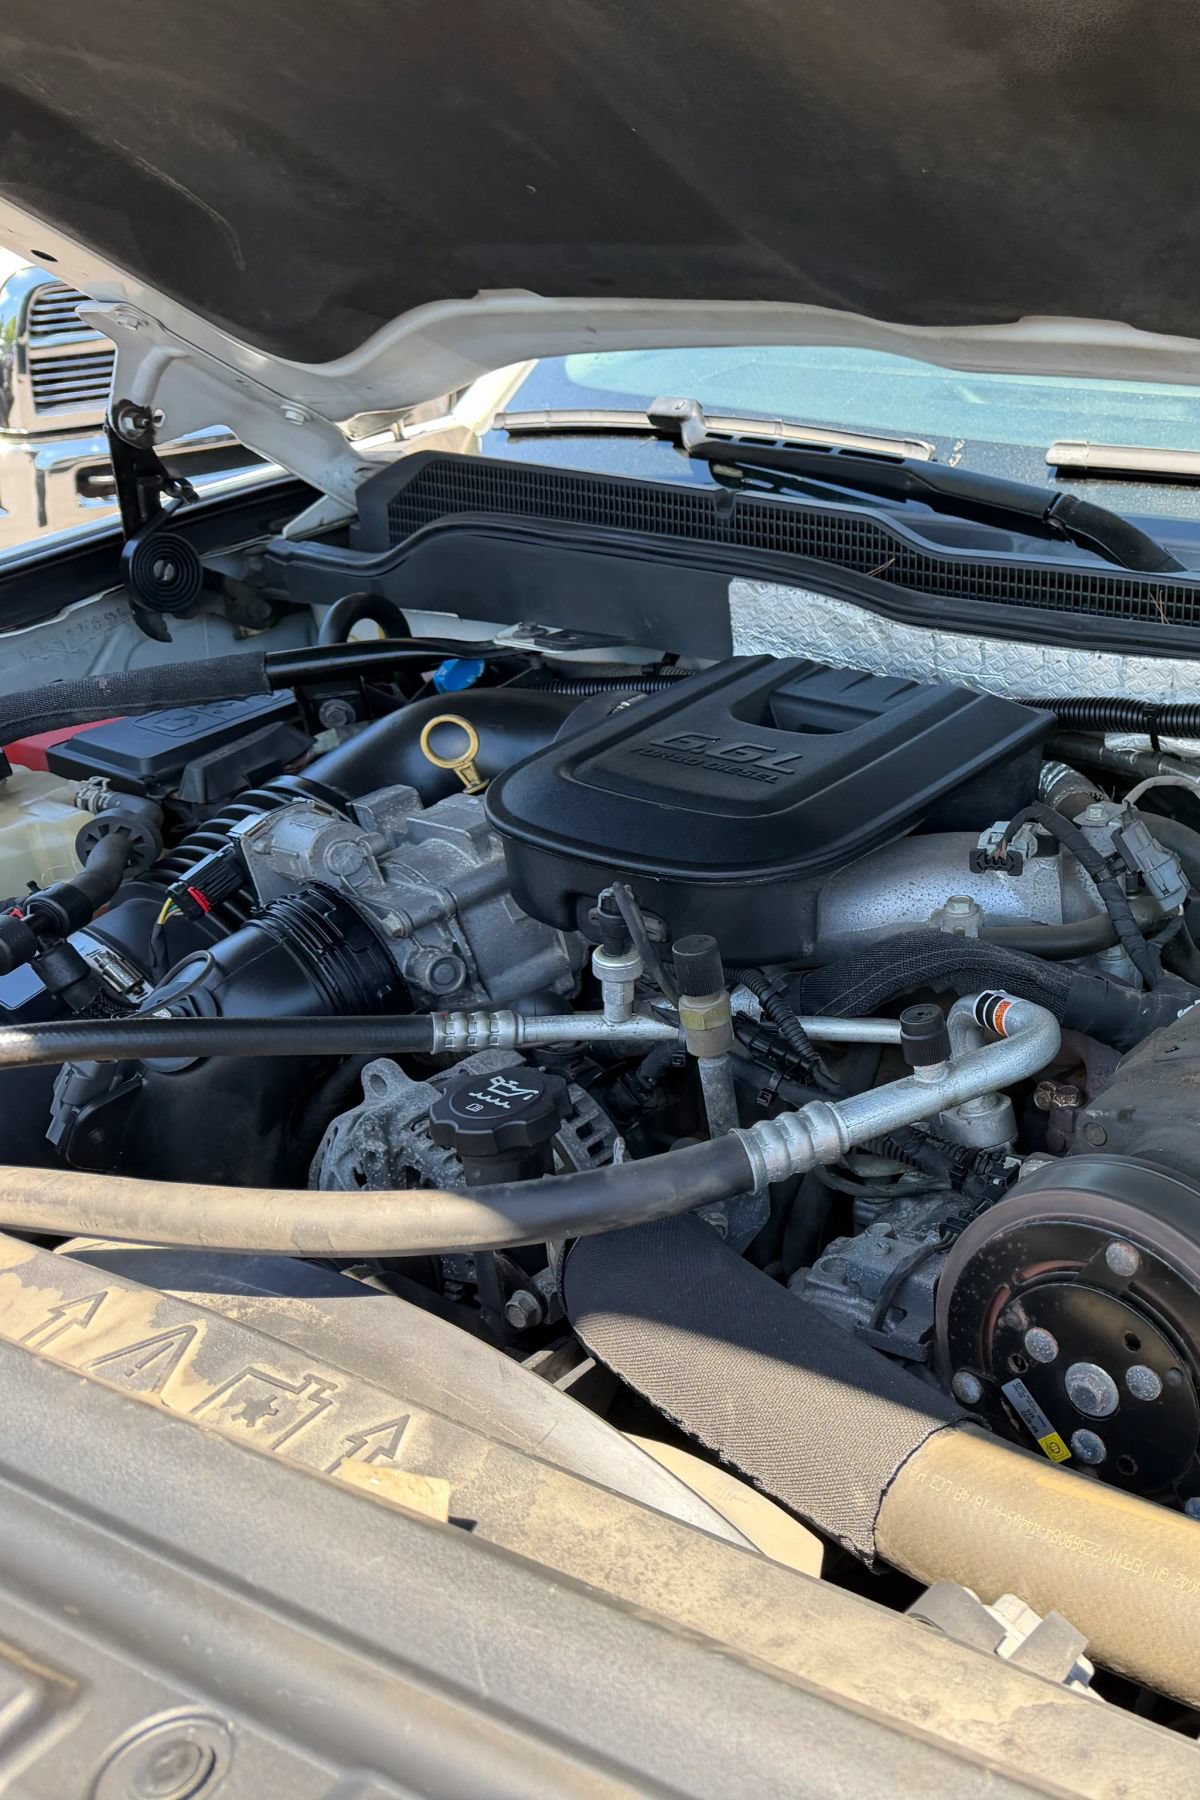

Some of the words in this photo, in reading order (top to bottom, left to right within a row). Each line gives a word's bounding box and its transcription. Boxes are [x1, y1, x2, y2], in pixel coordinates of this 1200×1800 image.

[630, 748, 705, 767] TURBO
[701, 761, 780, 785] DIESEL
[649, 731, 803, 775] 6.6L
